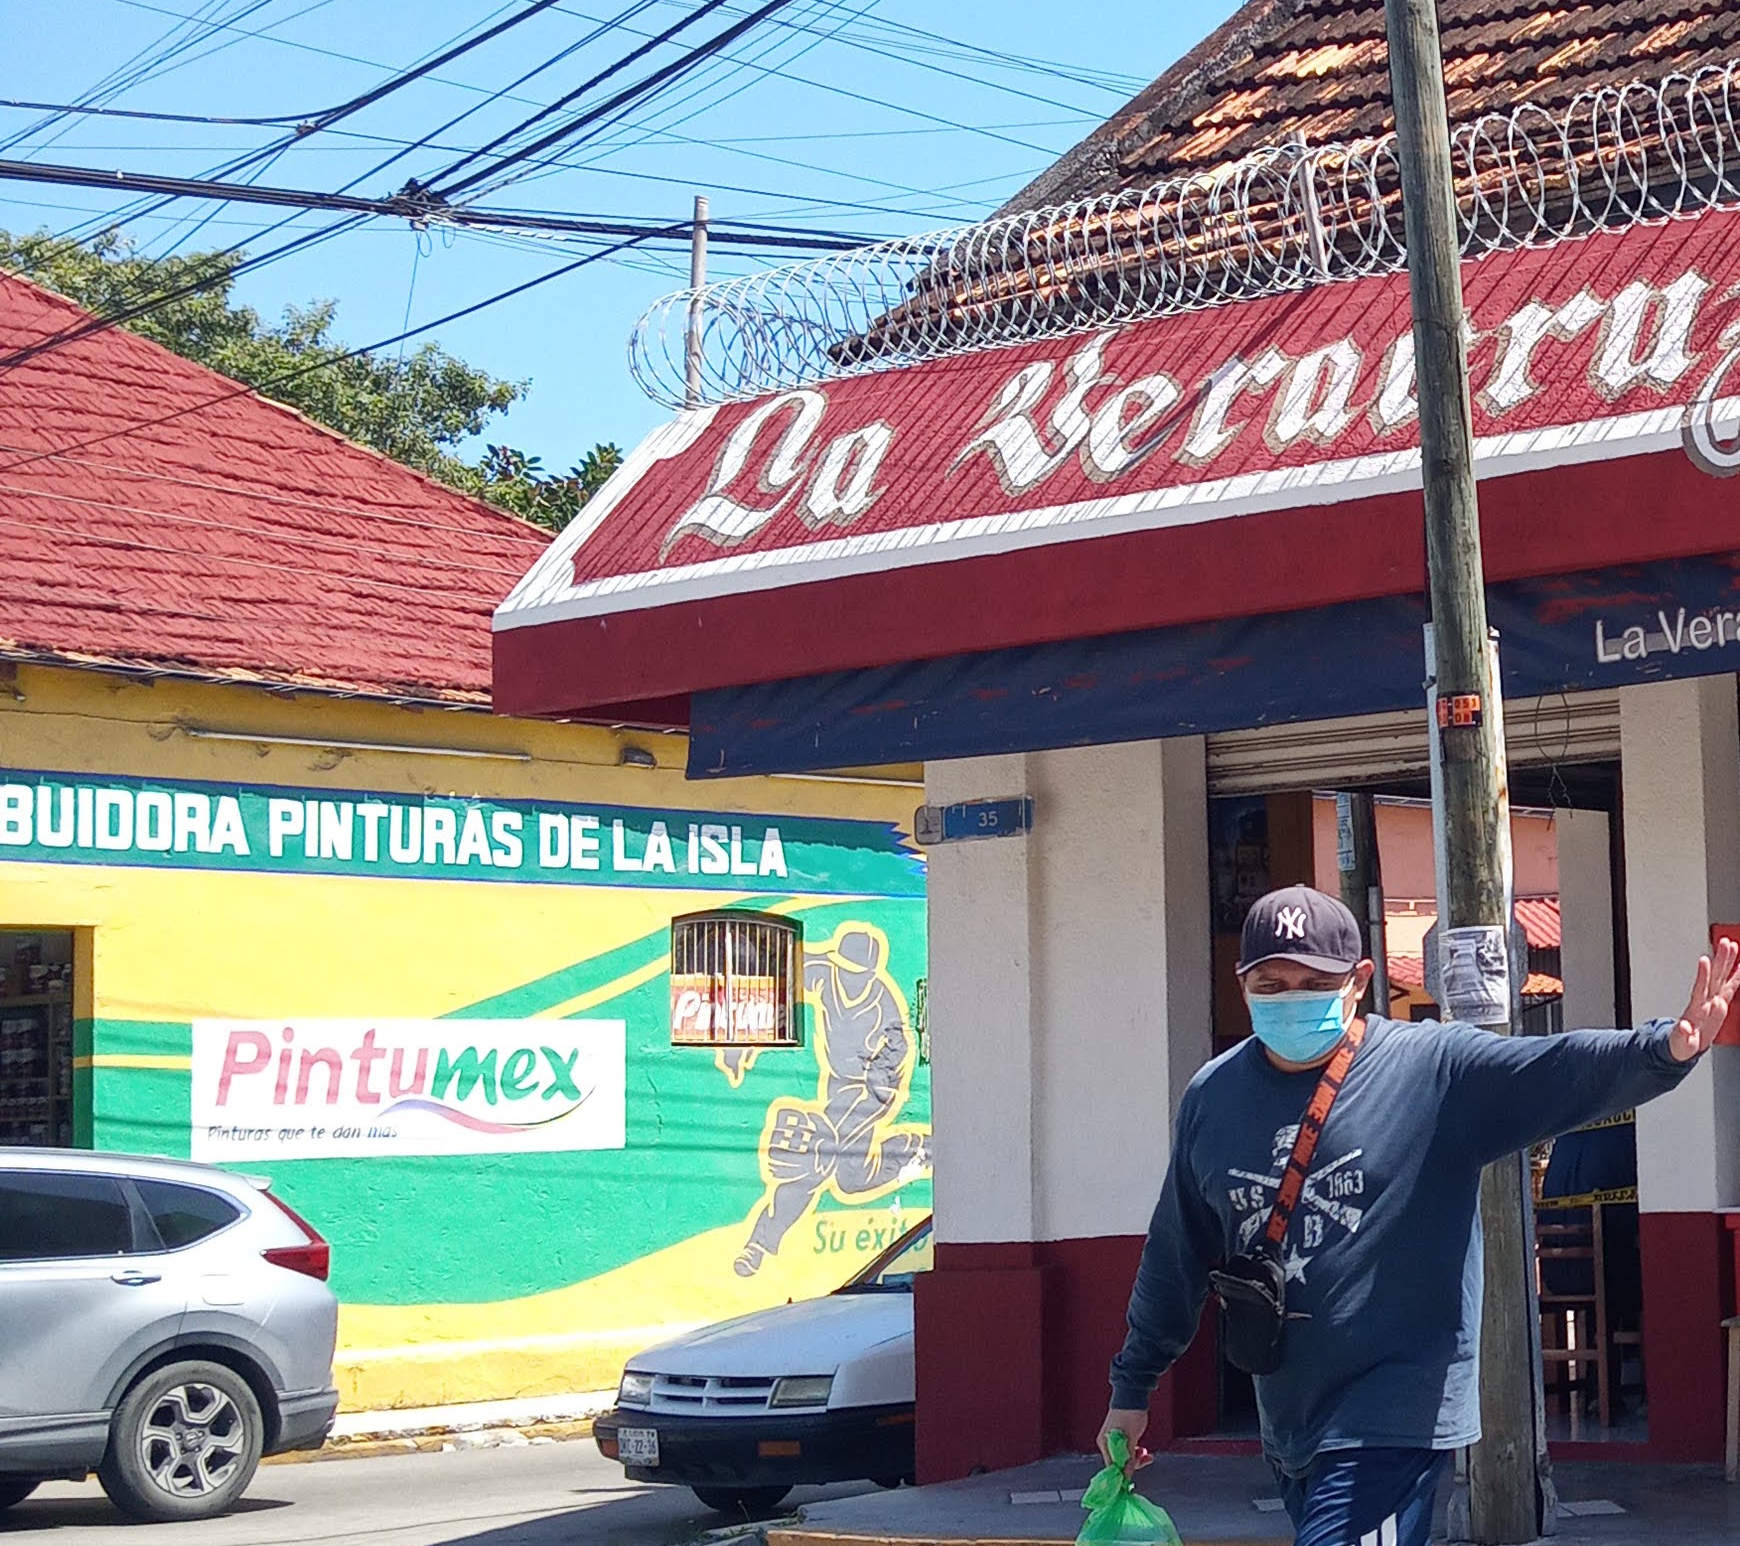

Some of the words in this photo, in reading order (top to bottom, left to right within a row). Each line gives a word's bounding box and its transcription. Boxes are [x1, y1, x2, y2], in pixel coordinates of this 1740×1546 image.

[658, 386, 890, 565] La
[1595, 619, 1648, 665] La
[268, 797, 523, 869] PINTURAS
[539, 812, 600, 871] DE
[613, 819, 677, 874] LA
[688, 822, 789, 878] ISLA
[214, 1027, 583, 1107] Pintumex
[207, 1124, 271, 1141] Pinturas
[277, 1127, 304, 1142] que
[309, 1124, 326, 1140] te
[333, 1123, 362, 1140] dan
[813, 1219, 846, 1254] Su
